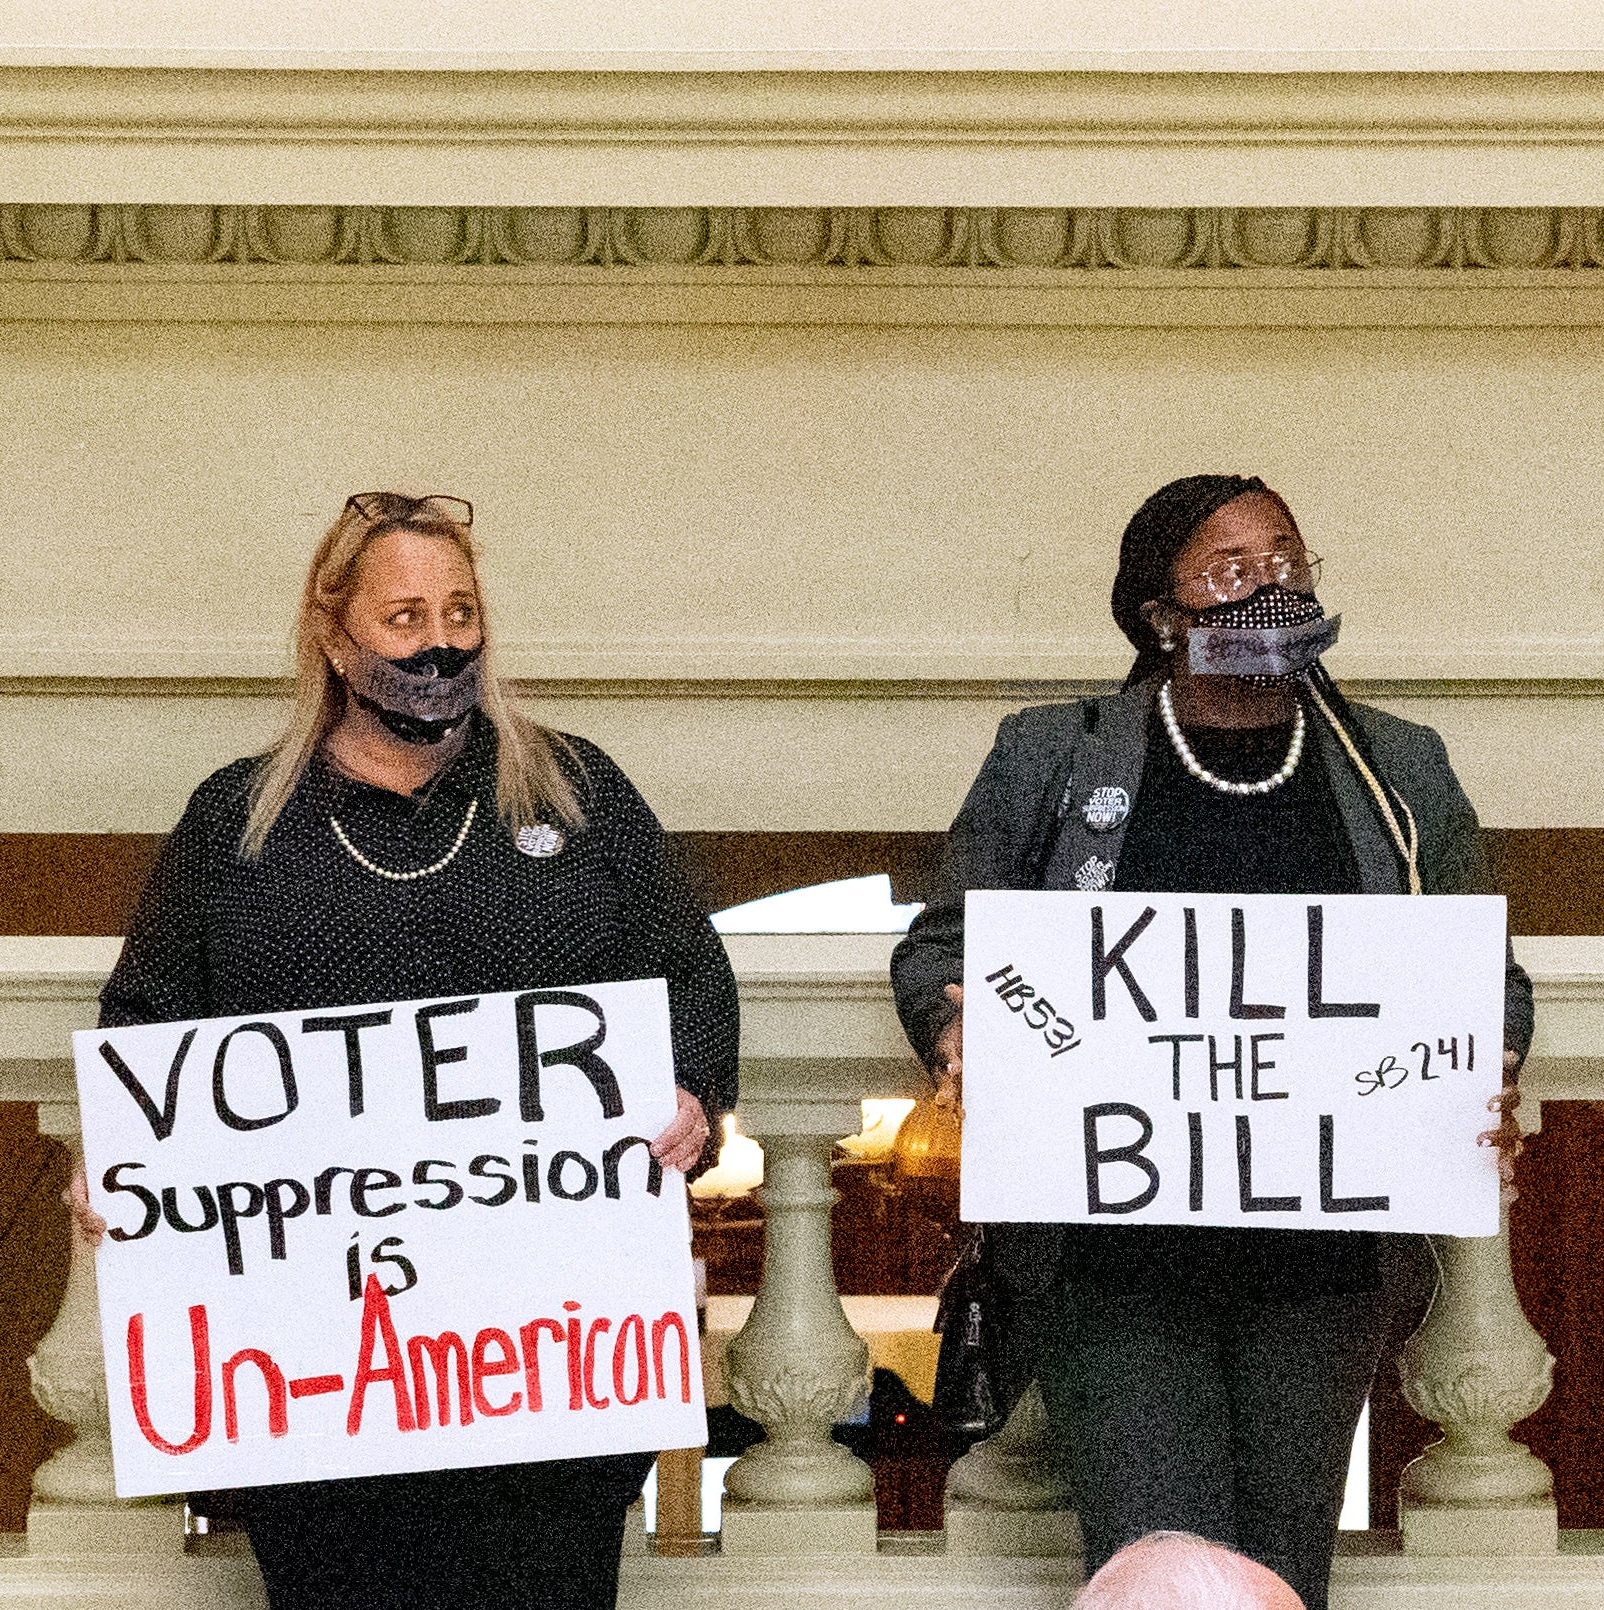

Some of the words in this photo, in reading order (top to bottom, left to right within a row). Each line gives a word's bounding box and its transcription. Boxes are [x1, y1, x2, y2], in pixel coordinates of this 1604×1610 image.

[1086, 811, 1116, 822] NOW!
[1093, 787, 1122, 798] STOP
[1075, 856, 1097, 882] STOP
[1090, 904, 1381, 1023] KILL
[984, 963, 1083, 1059] HB531
[98, 990, 626, 1142] VOTER
[1147, 1033, 1289, 1102] THE
[1354, 1055, 1409, 1097] SB
[1409, 1032, 1475, 1081] 241
[1083, 1102, 1390, 1215] BILL
[102, 1136, 663, 1277] Suppression
[346, 1230, 418, 1302] is
[126, 1272, 693, 1457] Un-American
